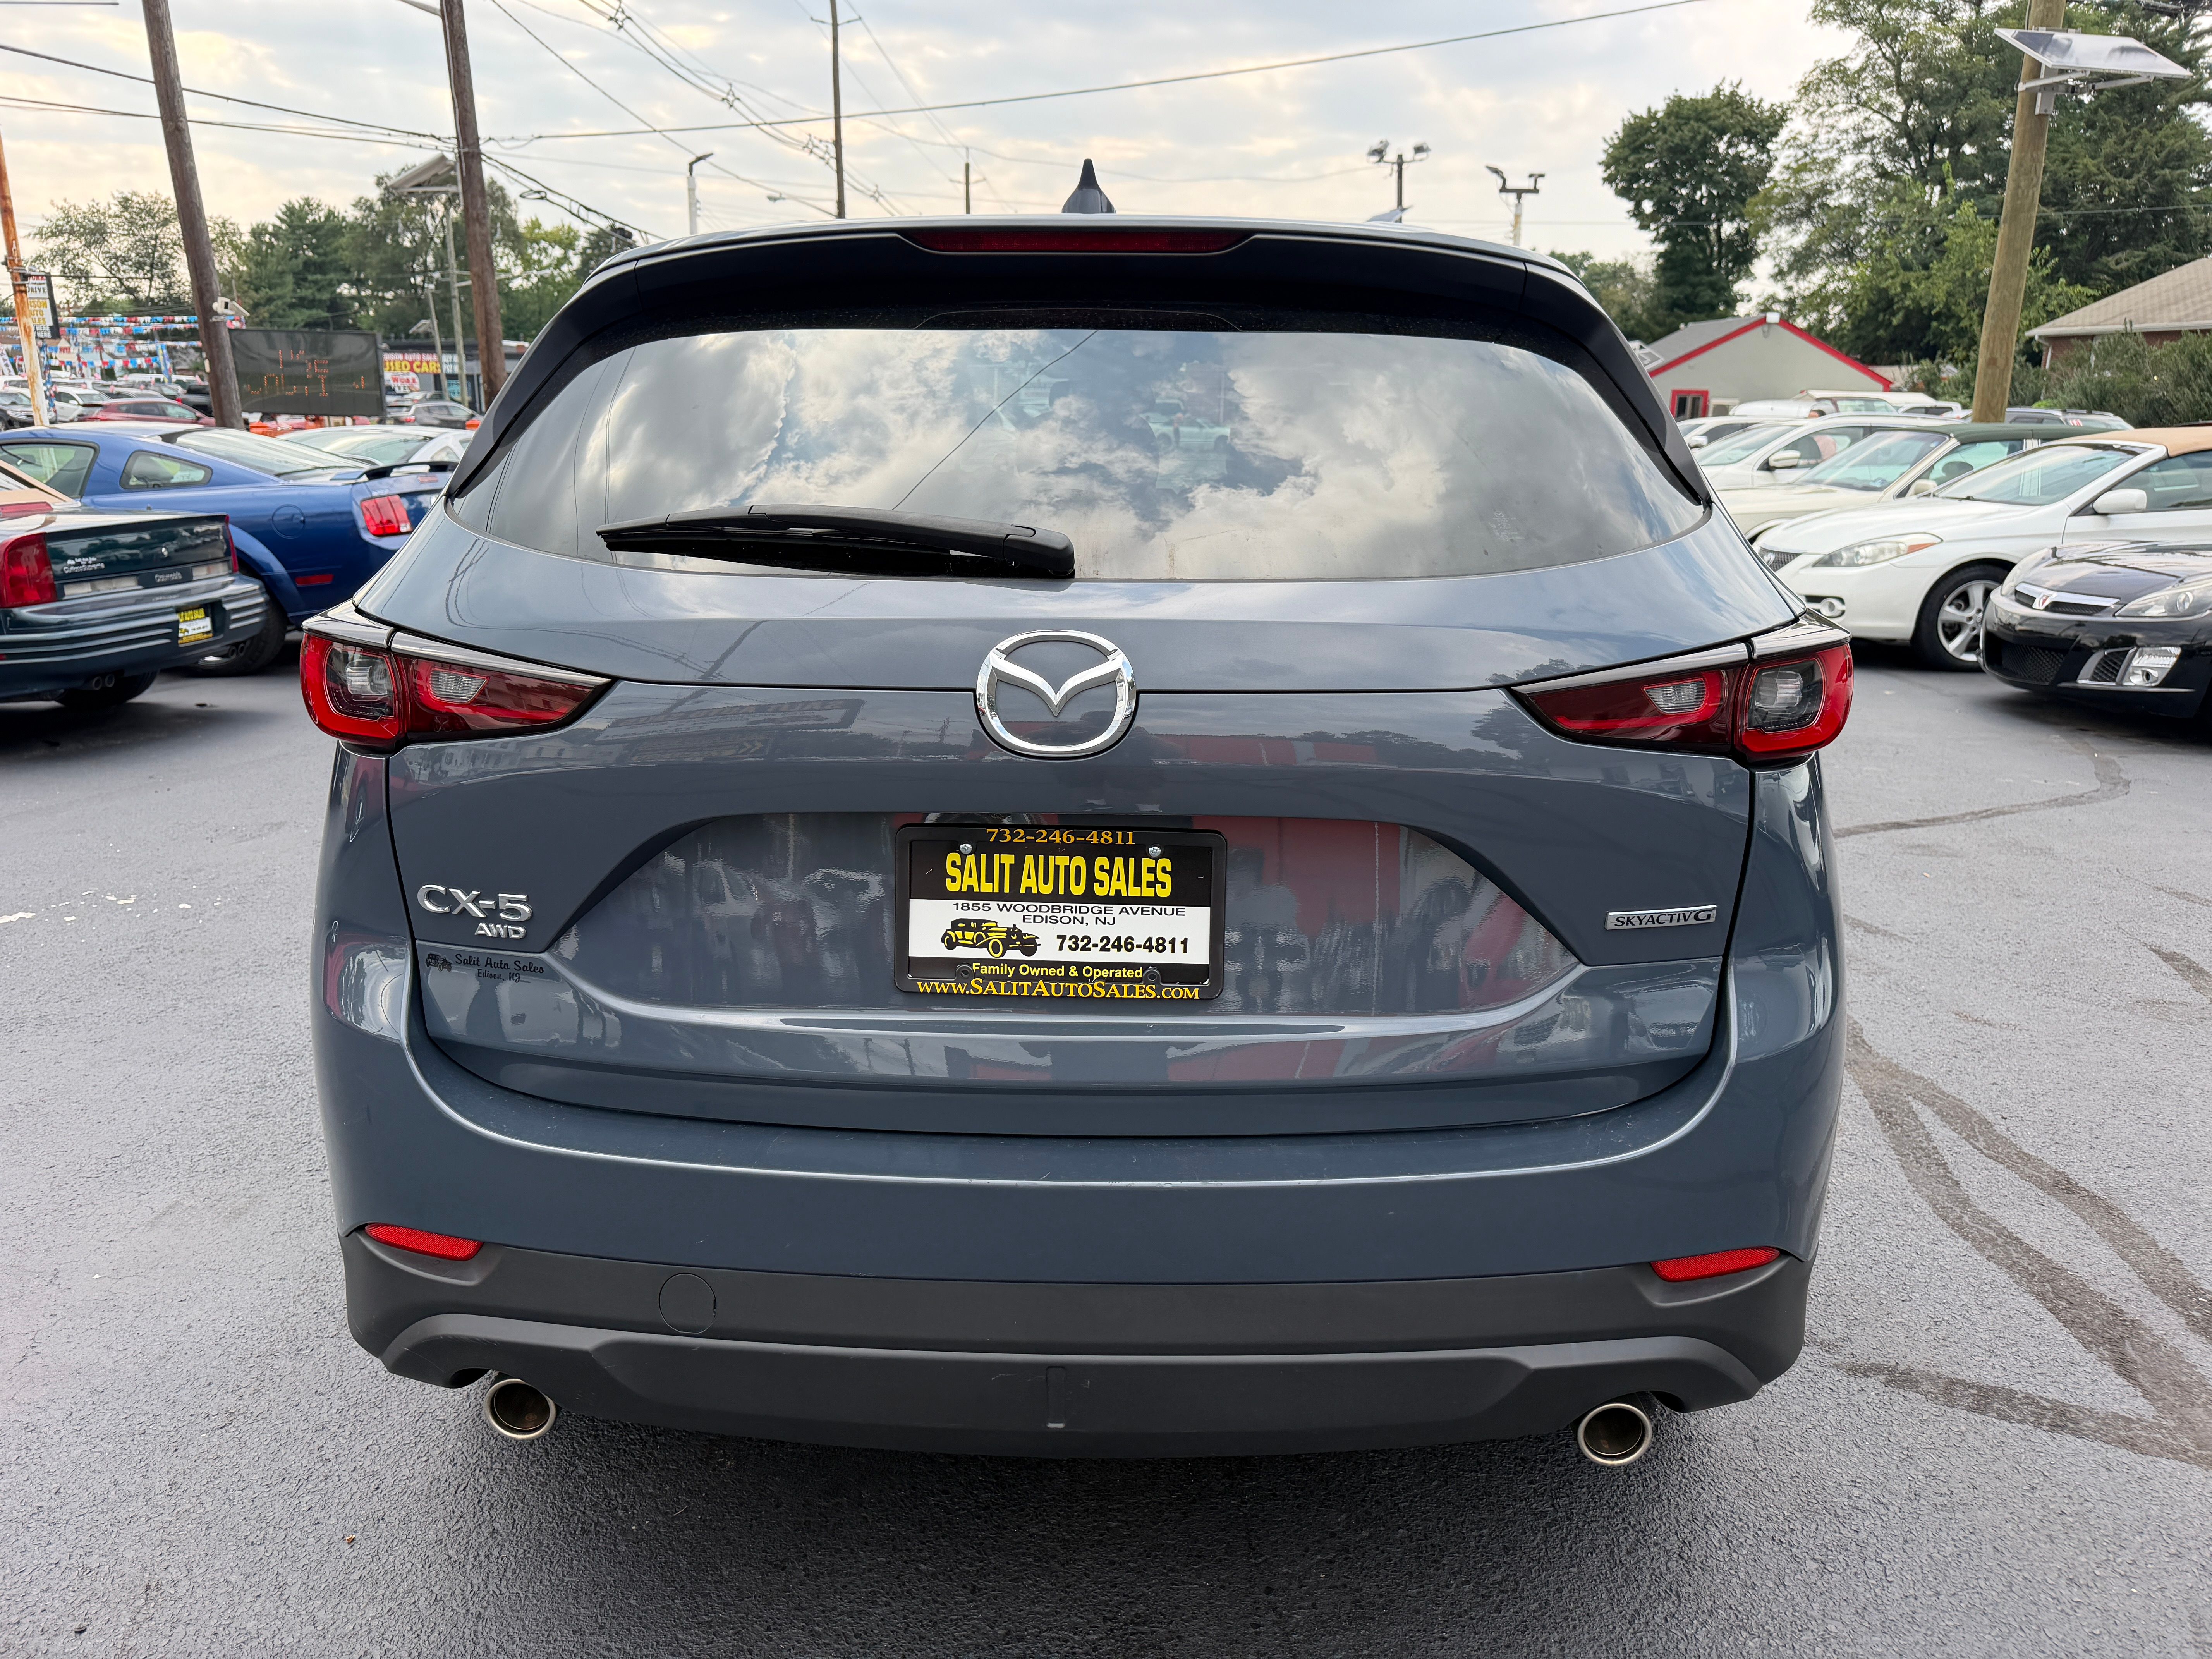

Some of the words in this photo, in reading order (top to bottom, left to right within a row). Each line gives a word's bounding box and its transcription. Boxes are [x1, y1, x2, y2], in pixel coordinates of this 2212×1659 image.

[29, 300, 48, 309] ISON
[404, 353, 421, 361] AUTO
[422, 353, 438, 361] SALE
[384, 361, 410, 371] USED
[986, 829, 1135, 844] 732-246-4811
[946, 852, 1015, 893] SALIT
[1020, 855, 1086, 895] AUTO
[1094, 857, 1172, 898] SALES
[417, 884, 533, 922] CX-5
[953, 902, 991, 912] 1855
[996, 903, 1114, 914] WOODBRIDGE
[1118, 906, 1186, 916] AVENUE
[1022, 915, 1089, 926] EDISON,
[1095, 917, 1116, 925] NJ
[474, 922, 527, 939] AWD
[1056, 934, 1188, 954] 732-246-4811
[455, 953, 480, 966] Salit
[484, 957, 510, 969] Auto
[514, 960, 544, 973] Sales
[972, 962, 1015, 977] Family
[1019, 964, 1065, 977] Owned
[1069, 967, 1079, 977] &
[1082, 966, 1143, 979] Operated
[477, 969, 504, 981] Edison,
[508, 972, 520, 983] NJ
